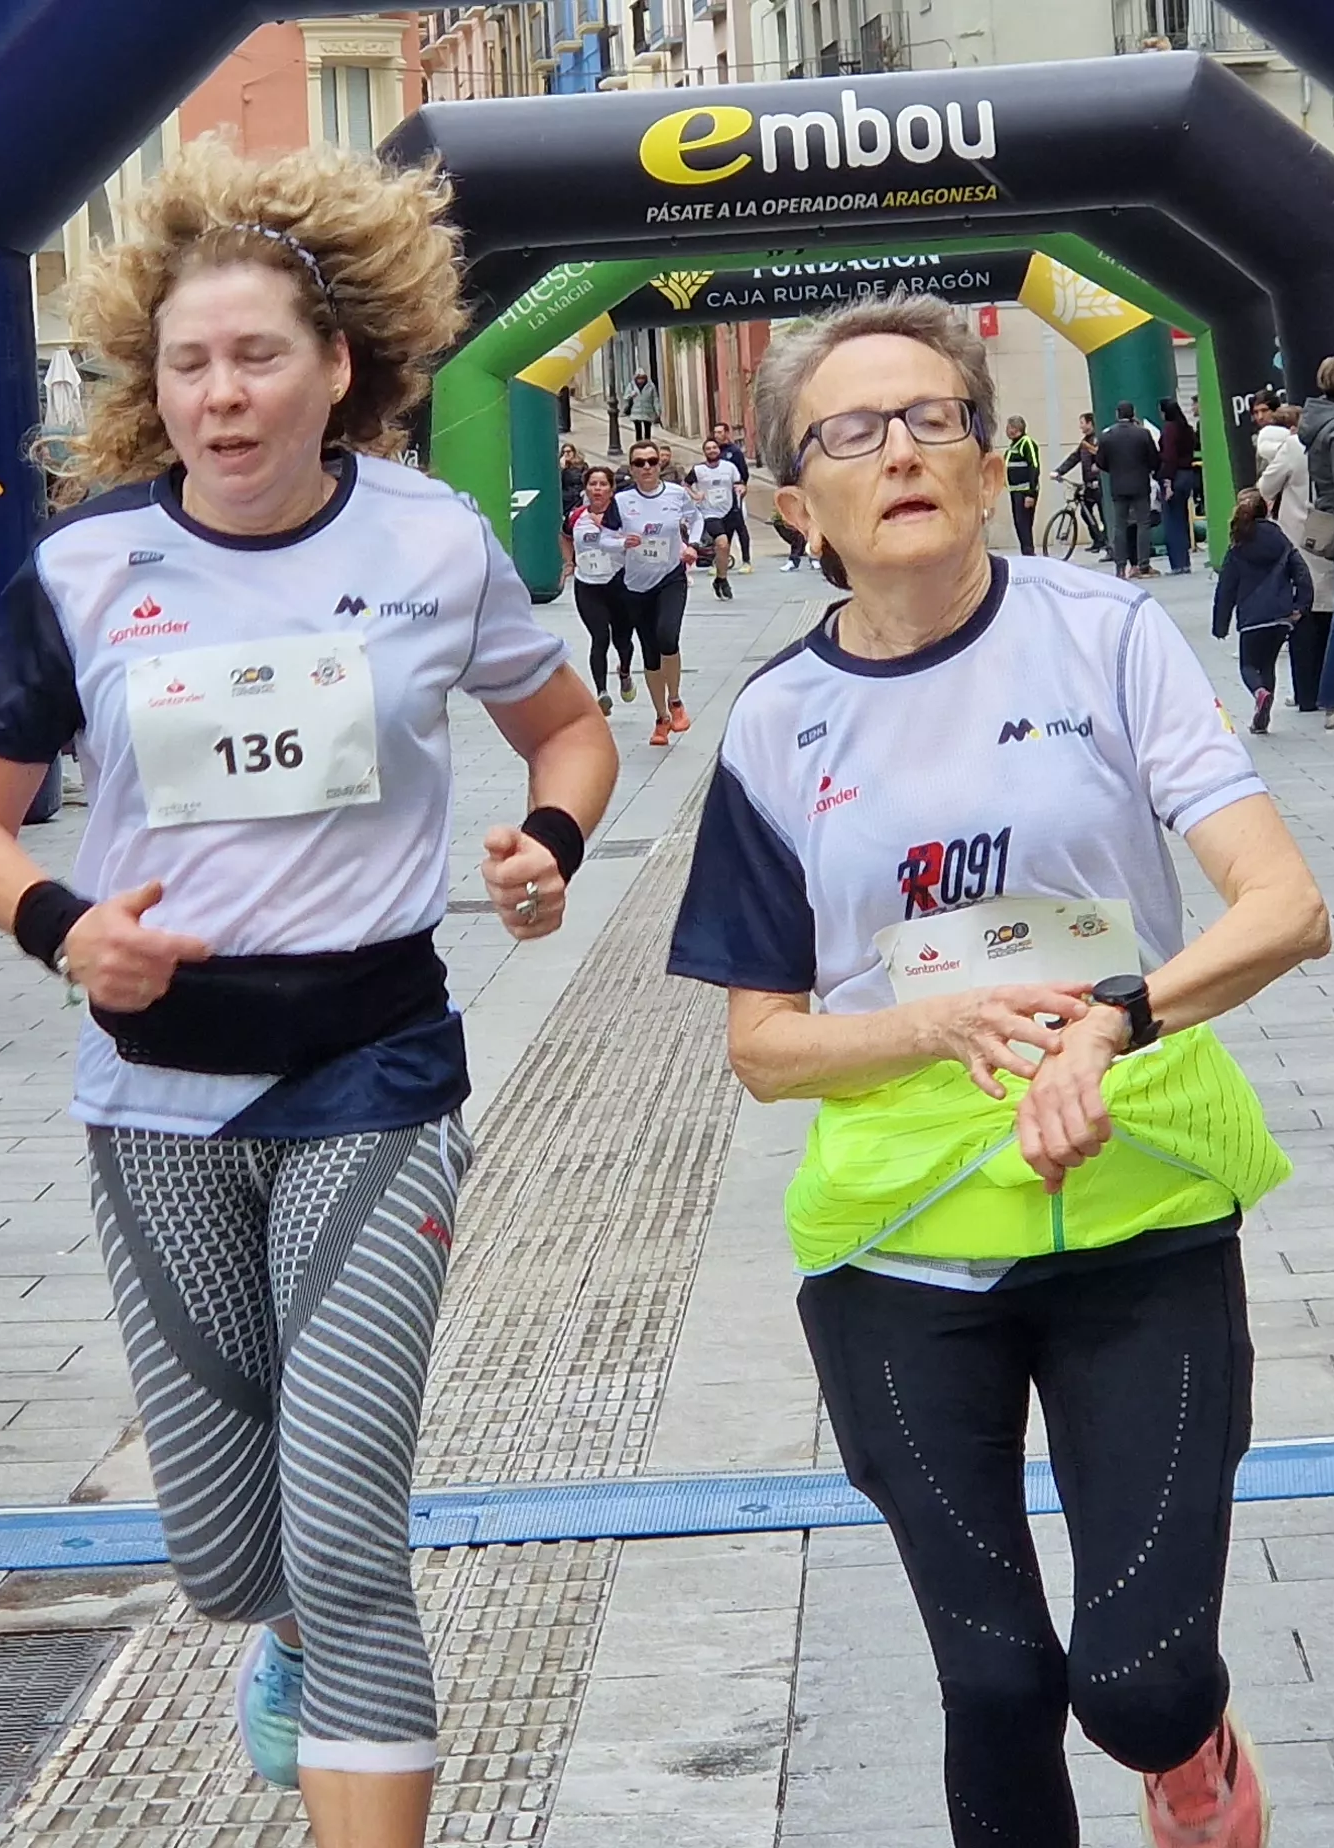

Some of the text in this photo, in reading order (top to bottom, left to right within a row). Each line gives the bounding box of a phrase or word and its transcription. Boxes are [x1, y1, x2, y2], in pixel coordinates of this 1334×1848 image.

[639, 88, 998, 186] embou
[646, 184, 998, 224] PÁSATE A LA OPERADORA ARAGONESA
[706, 270, 991, 308] CAJA RURAL DE ARAGÓN
[379, 597, 439, 621] mupol
[109, 620, 190, 645] Santander
[1046, 715, 1093, 738] muol
[213, 728, 304, 776] 136
[905, 959, 961, 978] Santander
